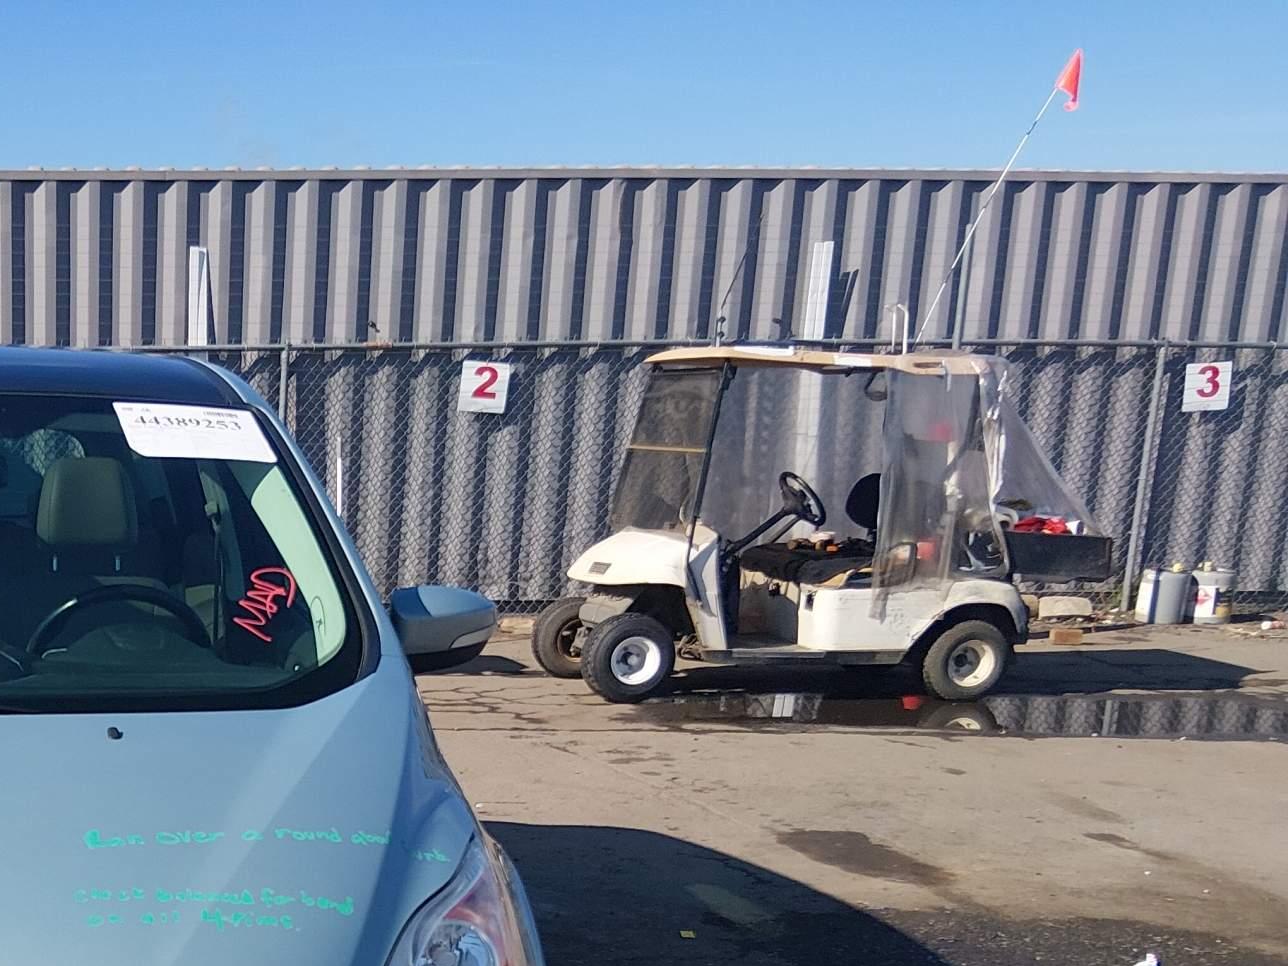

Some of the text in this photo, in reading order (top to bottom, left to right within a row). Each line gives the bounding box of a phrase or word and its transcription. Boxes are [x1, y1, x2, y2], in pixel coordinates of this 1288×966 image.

[471, 366, 499, 400] 2
[1196, 365, 1220, 398] 3
[134, 414, 243, 431] 44389253
[156, 830, 225, 845] over
